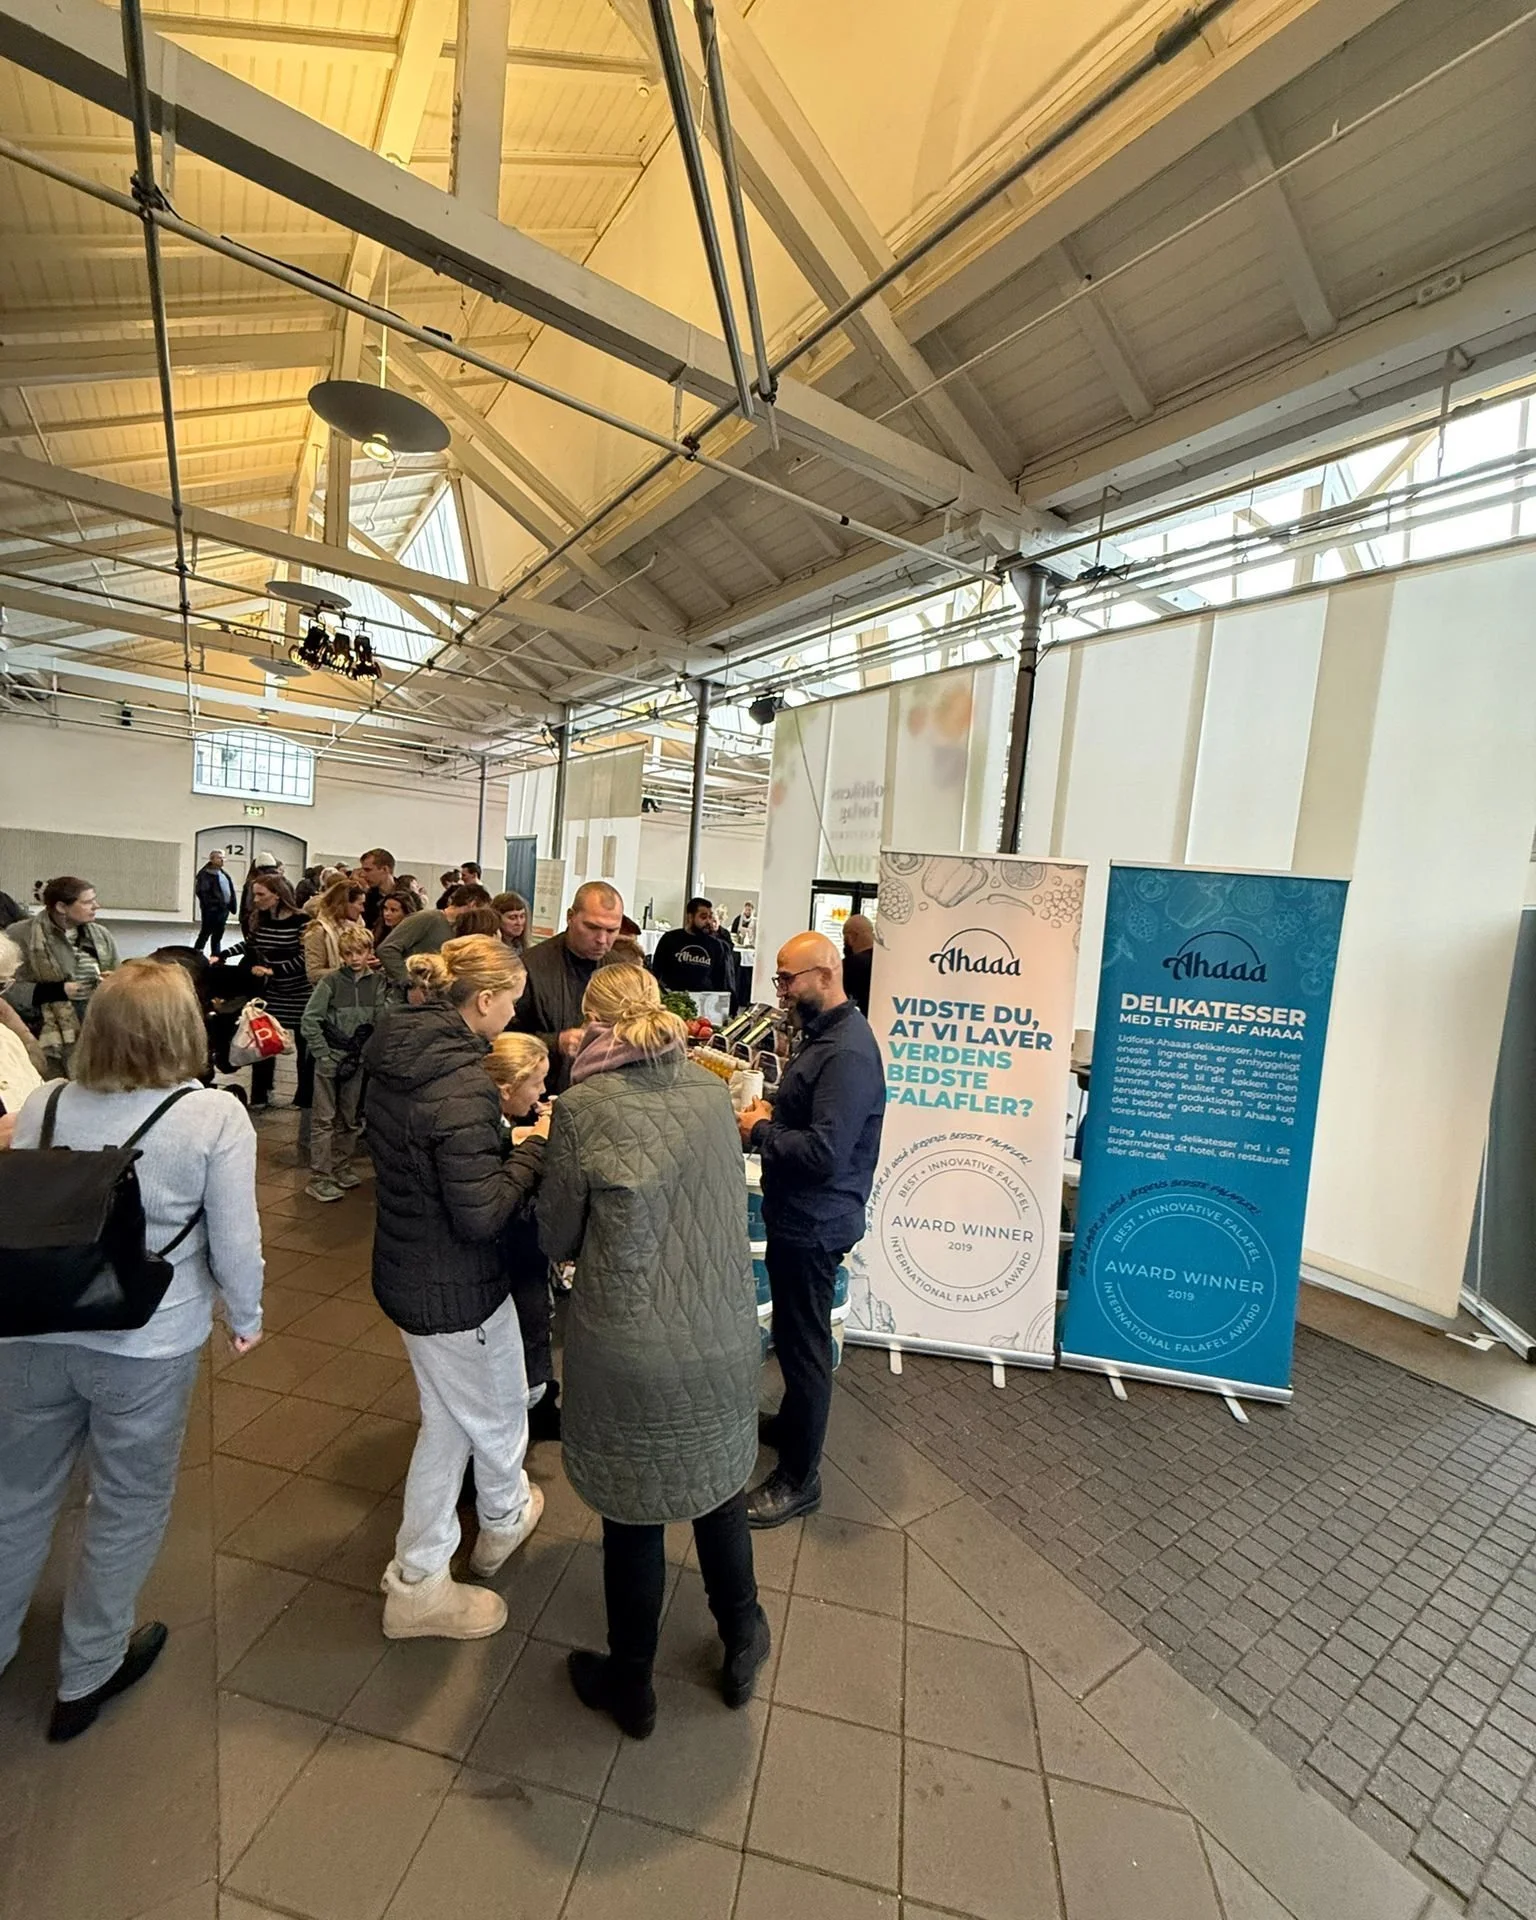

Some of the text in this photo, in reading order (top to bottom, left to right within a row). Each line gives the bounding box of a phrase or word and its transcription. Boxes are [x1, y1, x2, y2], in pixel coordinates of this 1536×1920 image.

[226, 844, 244, 856] 12
[675, 951, 711, 966] Ahaaa
[929, 947, 1021, 976] Ahaaa
[1163, 951, 1268, 983] Ahaaa
[892, 996, 1039, 1030] VIDSTE DU,
[1121, 993, 1307, 1027] DELIKATESSER
[889, 1020, 1053, 1050] AT VI LAVER
[1119, 1013, 1303, 1040] MED ET STREJF AF AHAAA
[888, 1041, 1012, 1069] VERDENS
[1117, 1046, 1149, 1055] eneste
[1157, 1050, 1208, 1061] ingrediens
[1236, 1057, 1300, 1071] omhyggeligt
[1118, 1035, 1154, 1045] Udforsk
[1157, 1038, 1191, 1049] Ahaaas
[1255, 1048, 1278, 1058] hvor
[1280, 1051, 1301, 1060] hver
[887, 1063, 988, 1089] BEDSTE
[1115, 1066, 1189, 1080] smagsoplevelse
[1195, 1072, 1205, 1081] til
[1211, 1075, 1224, 1084] dit
[1277, 1083, 1297, 1092] Den
[1116, 1056, 1151, 1066] udvalgt
[1158, 1059, 1172, 1067] for
[1178, 1062, 1187, 1070] at
[1194, 1063, 1226, 1075] bringe
[1252, 1068, 1299, 1081] autentisk
[1113, 1085, 1173, 1099] kendetegner
[1177, 1093, 1243, 1107] produktionen
[1257, 1102, 1271, 1110] for
[1276, 1103, 1295, 1113] kun
[1114, 1076, 1149, 1086] samme
[1182, 1083, 1215, 1093] kvalitet
[1221, 1088, 1234, 1097] og
[886, 1086, 1033, 1117] FALAFLER?
[1111, 1107, 1136, 1116] vores
[1112, 1096, 1128, 1105] det
[1132, 1098, 1164, 1109] bedste
[1181, 1104, 1204, 1114] godt
[1208, 1106, 1227, 1115] nok
[1232, 1108, 1241, 1117] til
[1244, 1111, 1276, 1122] Ahaaa
[1280, 1116, 1294, 1125] og
[1107, 1147, 1126, 1156] eller
[1129, 1149, 1144, 1158] din
[1109, 1126, 1135, 1137] Bring
[1140, 1129, 1175, 1141] Ahaaas
[1180, 1134, 1237, 1148] delikatesser
[1244, 1142, 1261, 1152] ind
[1276, 1147, 1291, 1155] dit
[1174, 1144, 1187, 1153] dit
[1219, 1149, 1235, 1159] din
[1238, 1152, 1290, 1165] restaurant
[898, 1158, 1030, 1212] BEST INNOVATIVE FALAFEL
[891, 1216, 1034, 1243] AWARD WINNER
[1113, 1202, 1262, 1263] BEST INNOVATIVE FALAFEL
[948, 1242, 972, 1251] 2019
[890, 1236, 1031, 1302] INTERNATIONAL FALAFEL AWARD
[1105, 1260, 1265, 1295] AWARD WINNER
[1167, 1289, 1195, 1301] 2019
[1104, 1281, 1260, 1352] INTERNATIONAL FALAFEL AWARD
